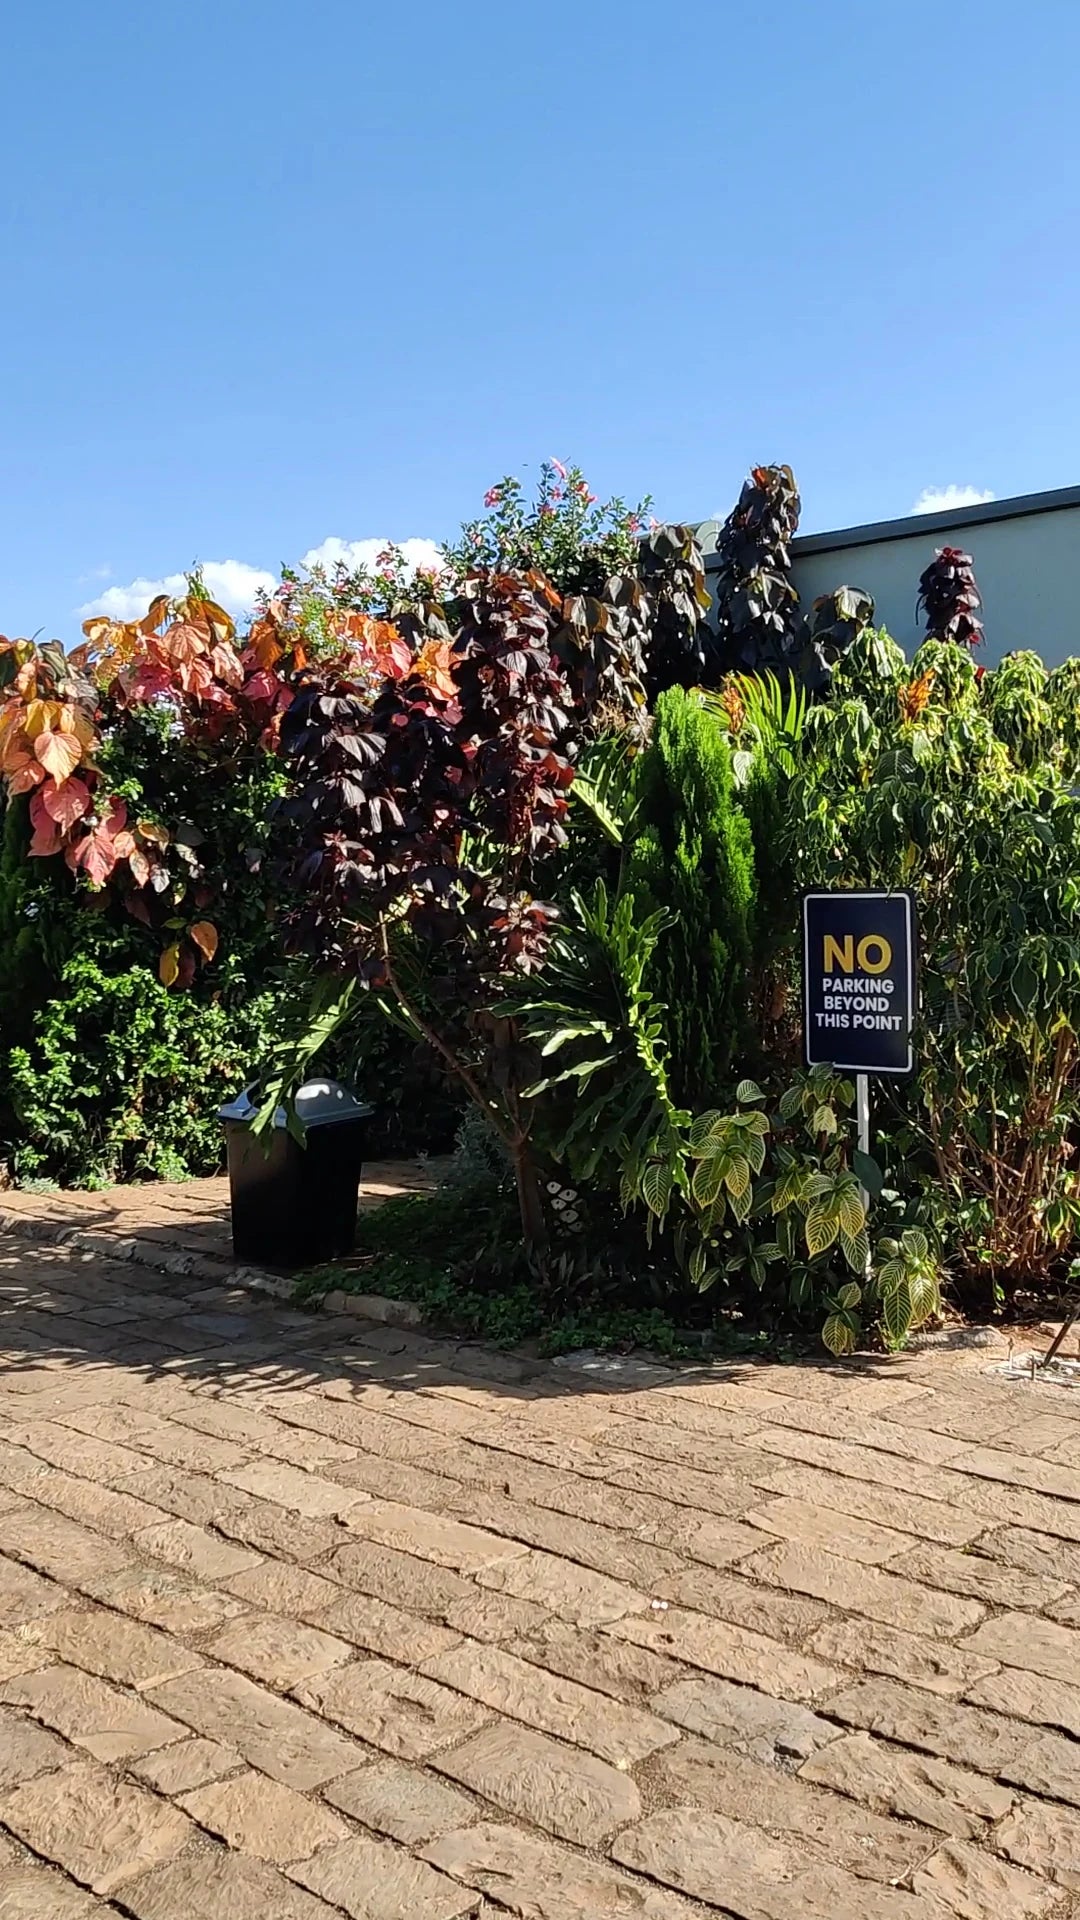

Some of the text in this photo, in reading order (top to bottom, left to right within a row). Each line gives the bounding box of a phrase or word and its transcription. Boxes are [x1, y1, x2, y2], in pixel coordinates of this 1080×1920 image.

[823, 934, 892, 974] NO
[822, 978, 895, 994] PARKING
[824, 996, 890, 1012] BEYOND
[815, 1013, 903, 1031] THIS POINT
